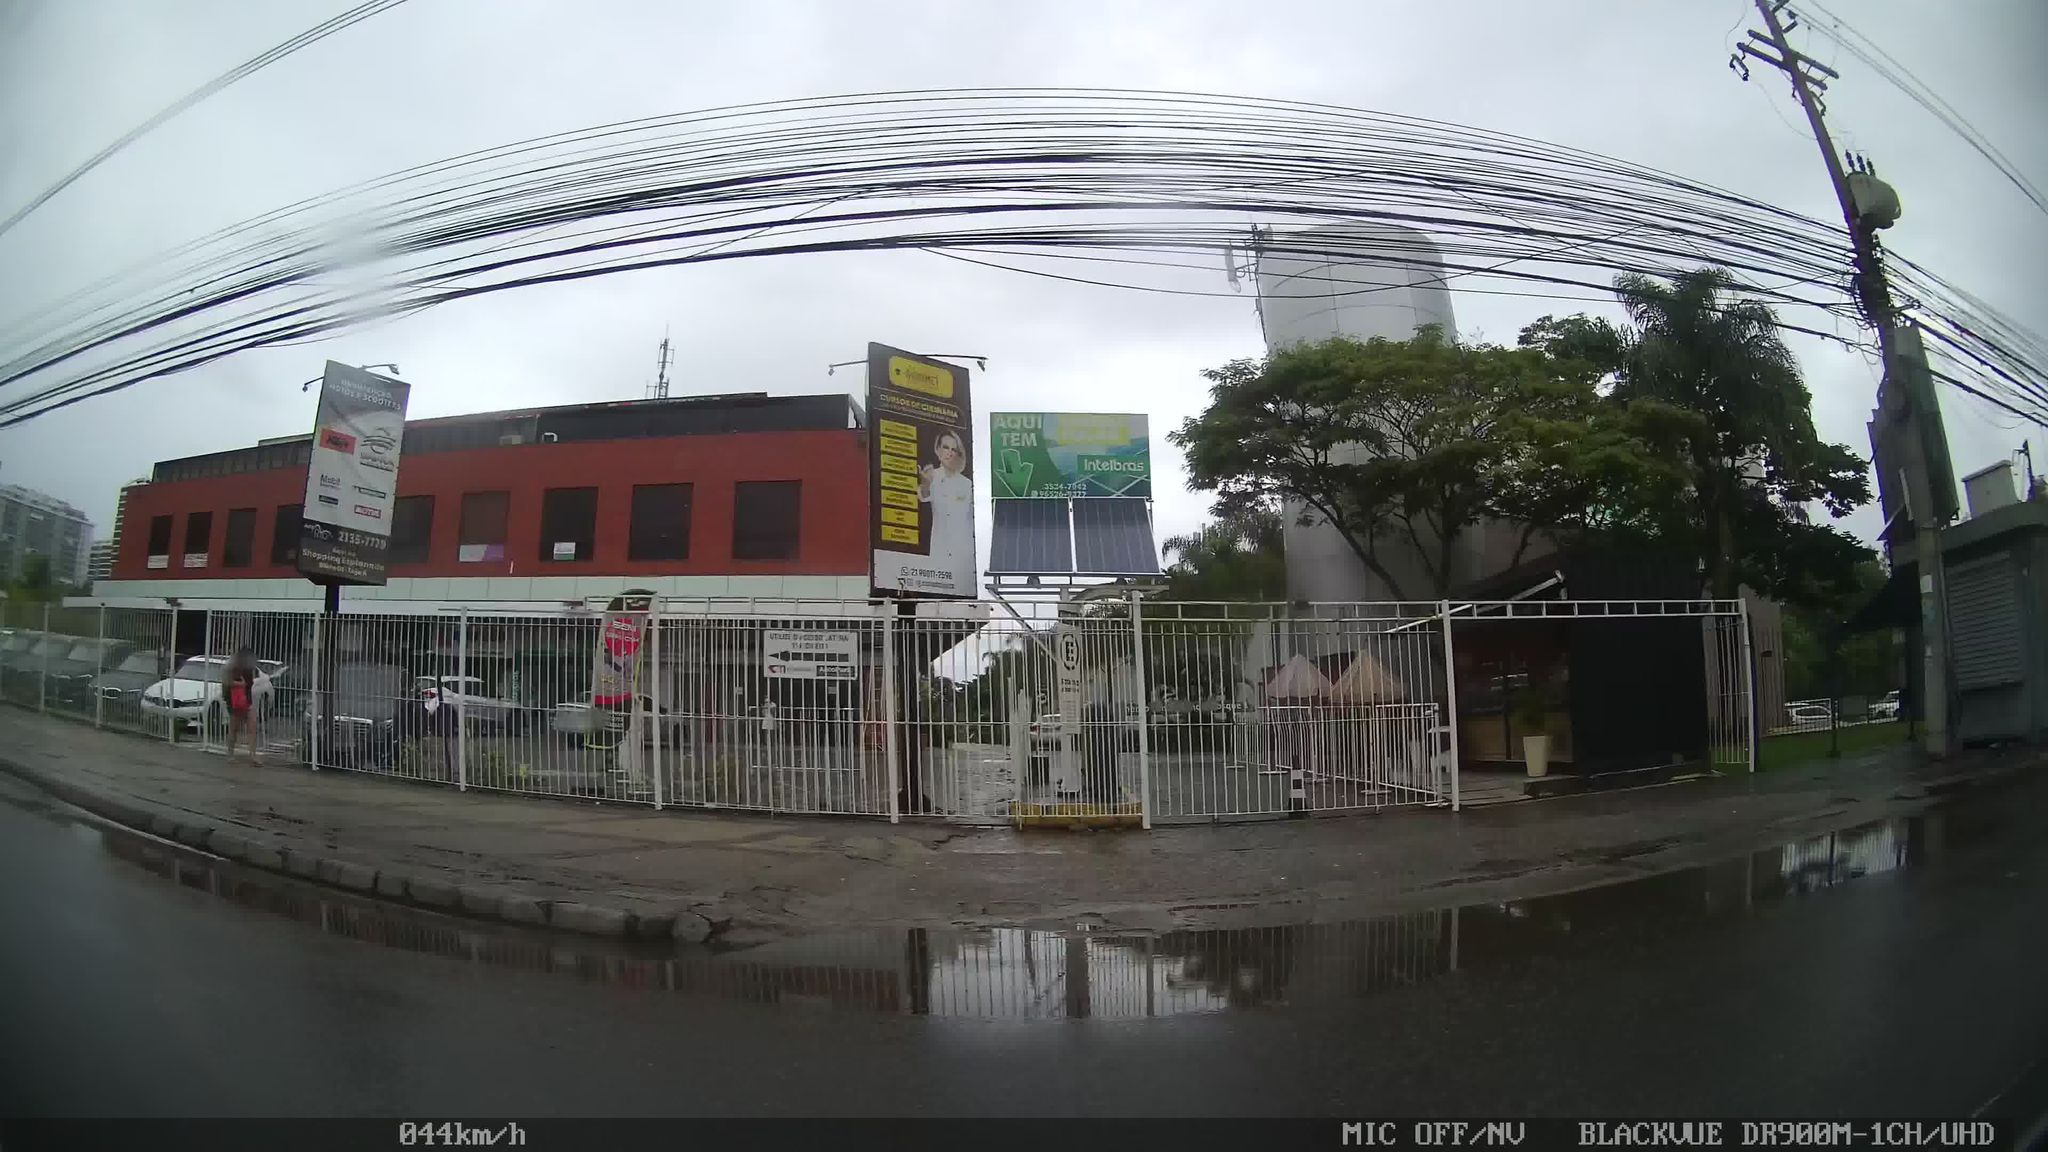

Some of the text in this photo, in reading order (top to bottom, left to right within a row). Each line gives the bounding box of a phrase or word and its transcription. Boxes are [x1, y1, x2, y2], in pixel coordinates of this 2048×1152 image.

[995, 414, 1042, 429] AQUI
[1001, 432, 1038, 447] TEM
[302, 548, 341, 564] Shopping
